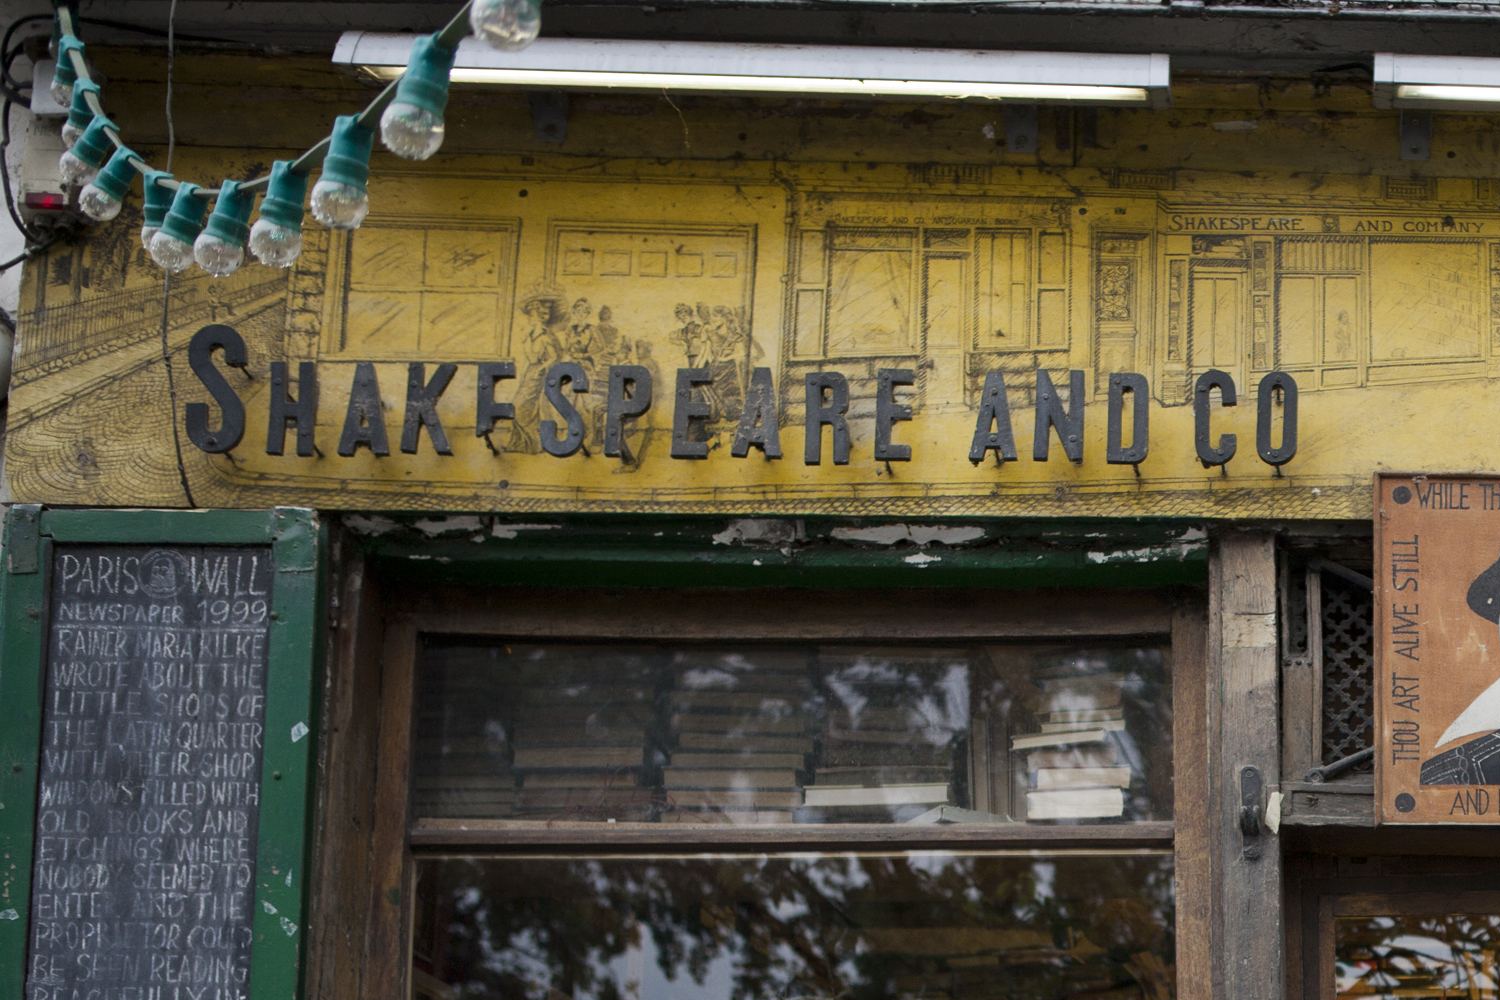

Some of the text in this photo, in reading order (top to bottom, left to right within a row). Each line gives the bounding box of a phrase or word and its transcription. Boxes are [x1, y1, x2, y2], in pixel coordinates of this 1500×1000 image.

[1167, 214, 1485, 233] SHAKESPEARE AND COMPANY
[968, 368, 1149, 466] AND
[1194, 368, 1298, 467] CO
[1416, 482, 1470, 510] WHILE
[61, 554, 267, 597] PARIS WALL
[58, 600, 267, 625] NEWSPAPER 1999
[1391, 534, 1420, 766] THOU ART ALIVE STILL
[53, 690, 265, 720] LITTLE SHOPS OF
[50, 719, 263, 751] THE LATIN QUARTER
[1449, 791, 1490, 816] AND
